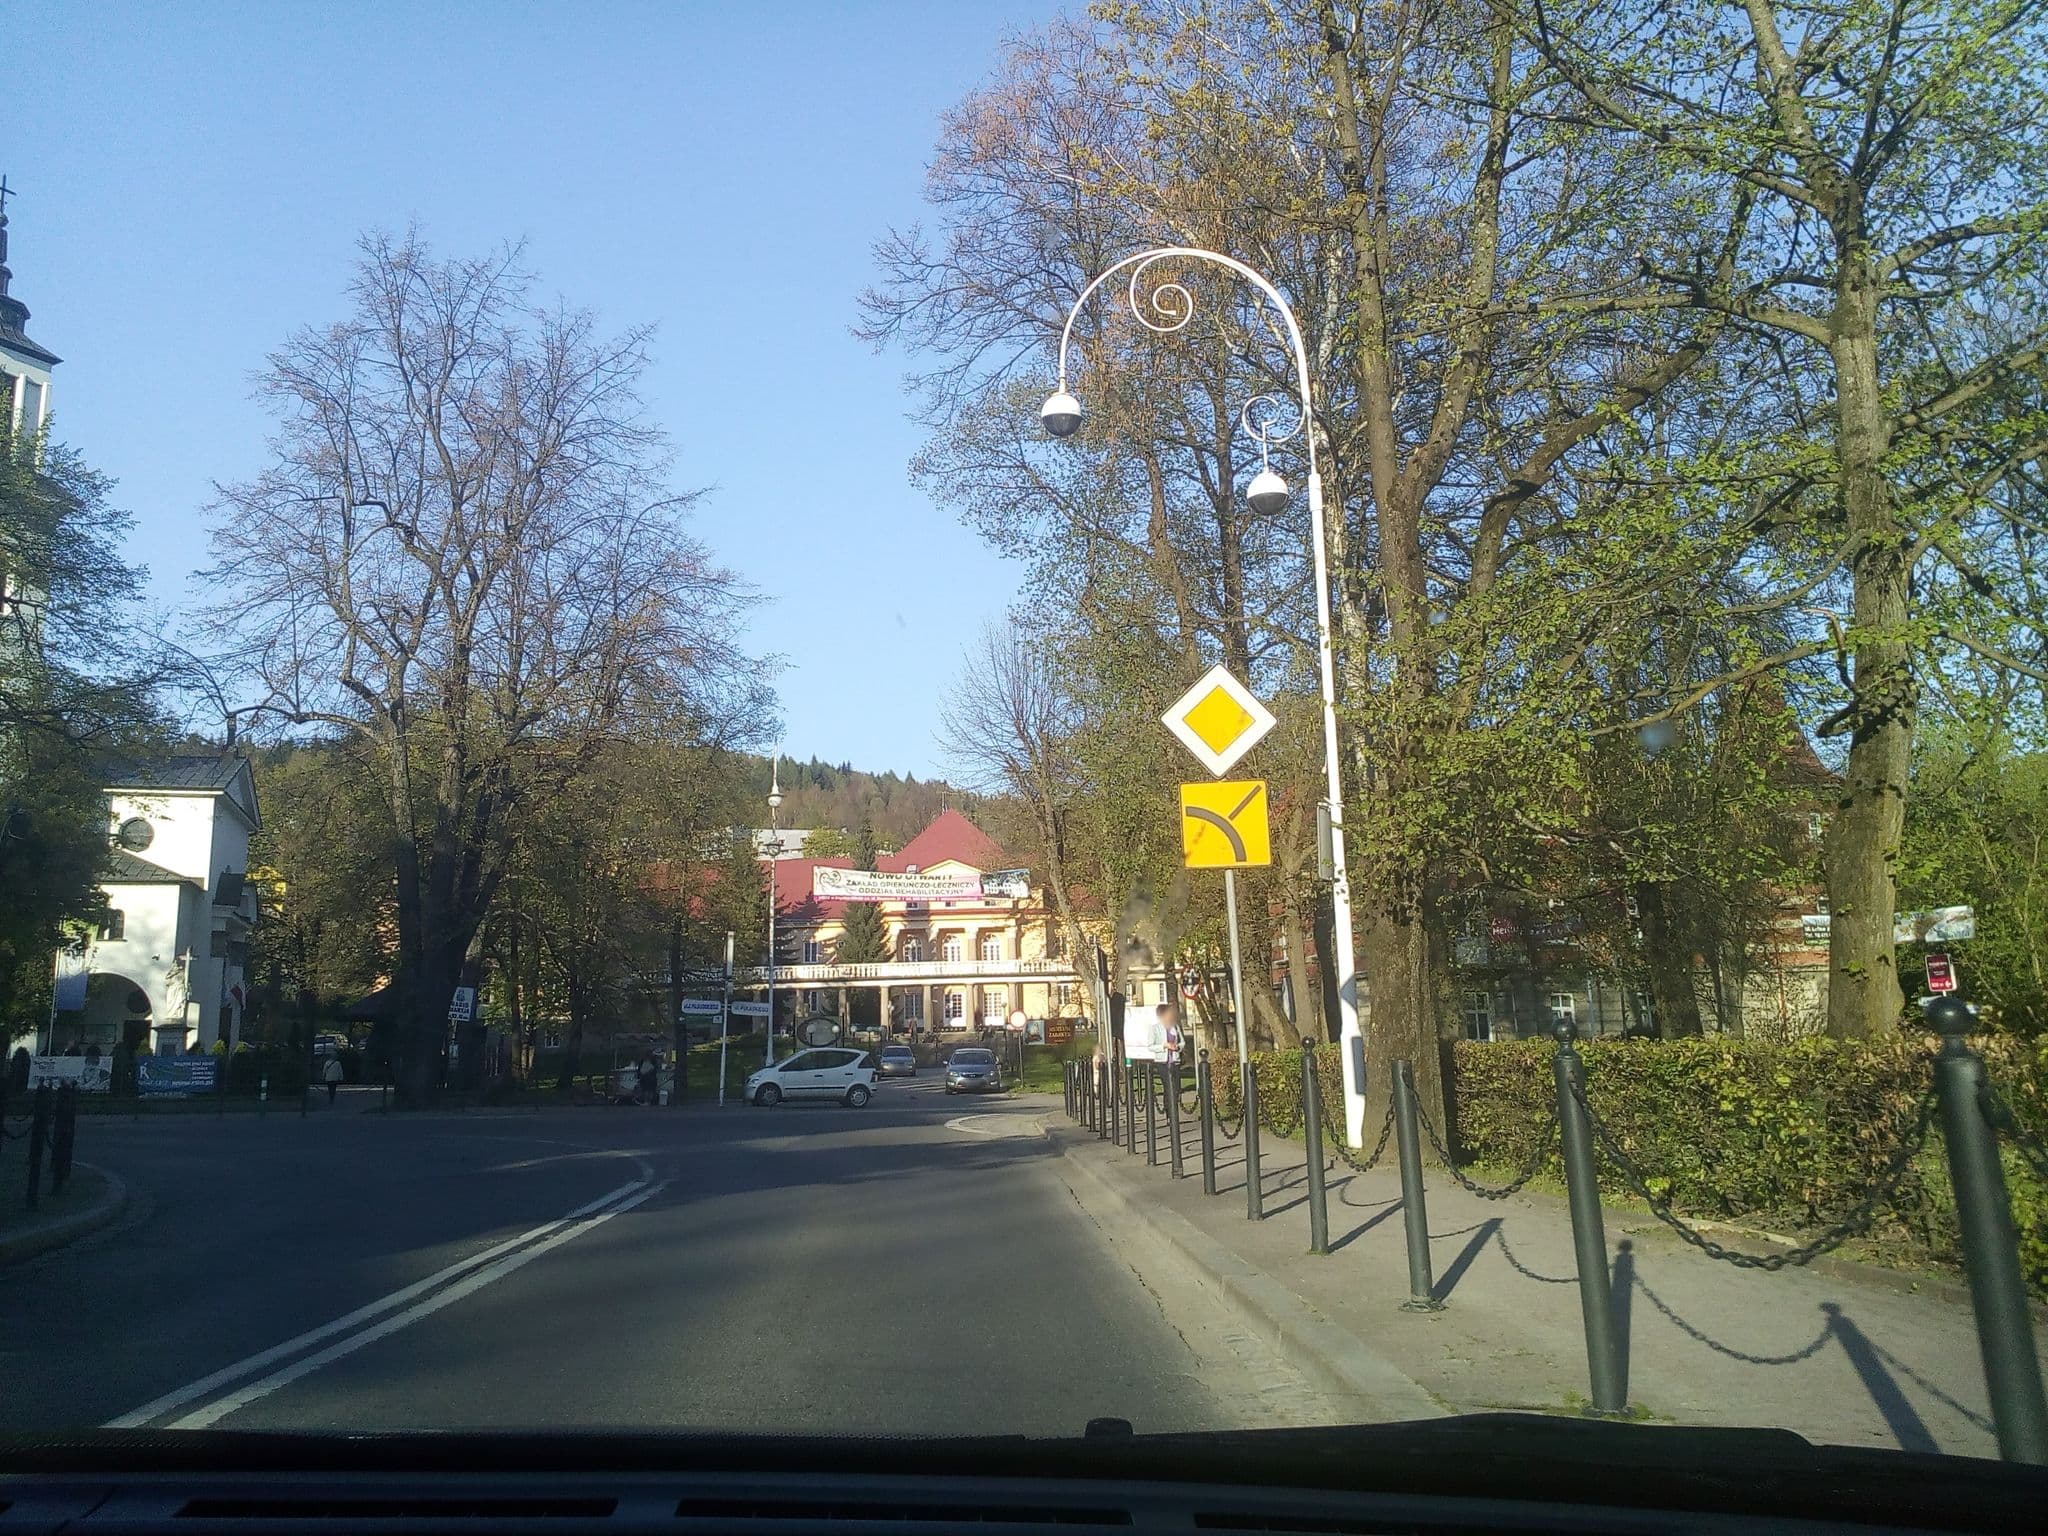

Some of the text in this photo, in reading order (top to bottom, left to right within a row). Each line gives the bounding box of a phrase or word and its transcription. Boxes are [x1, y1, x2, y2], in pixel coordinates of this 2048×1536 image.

[846, 879, 878, 887] ZAKŁAD
[858, 886, 964, 896] ODDZIAŁ REHABILITACYJNY
